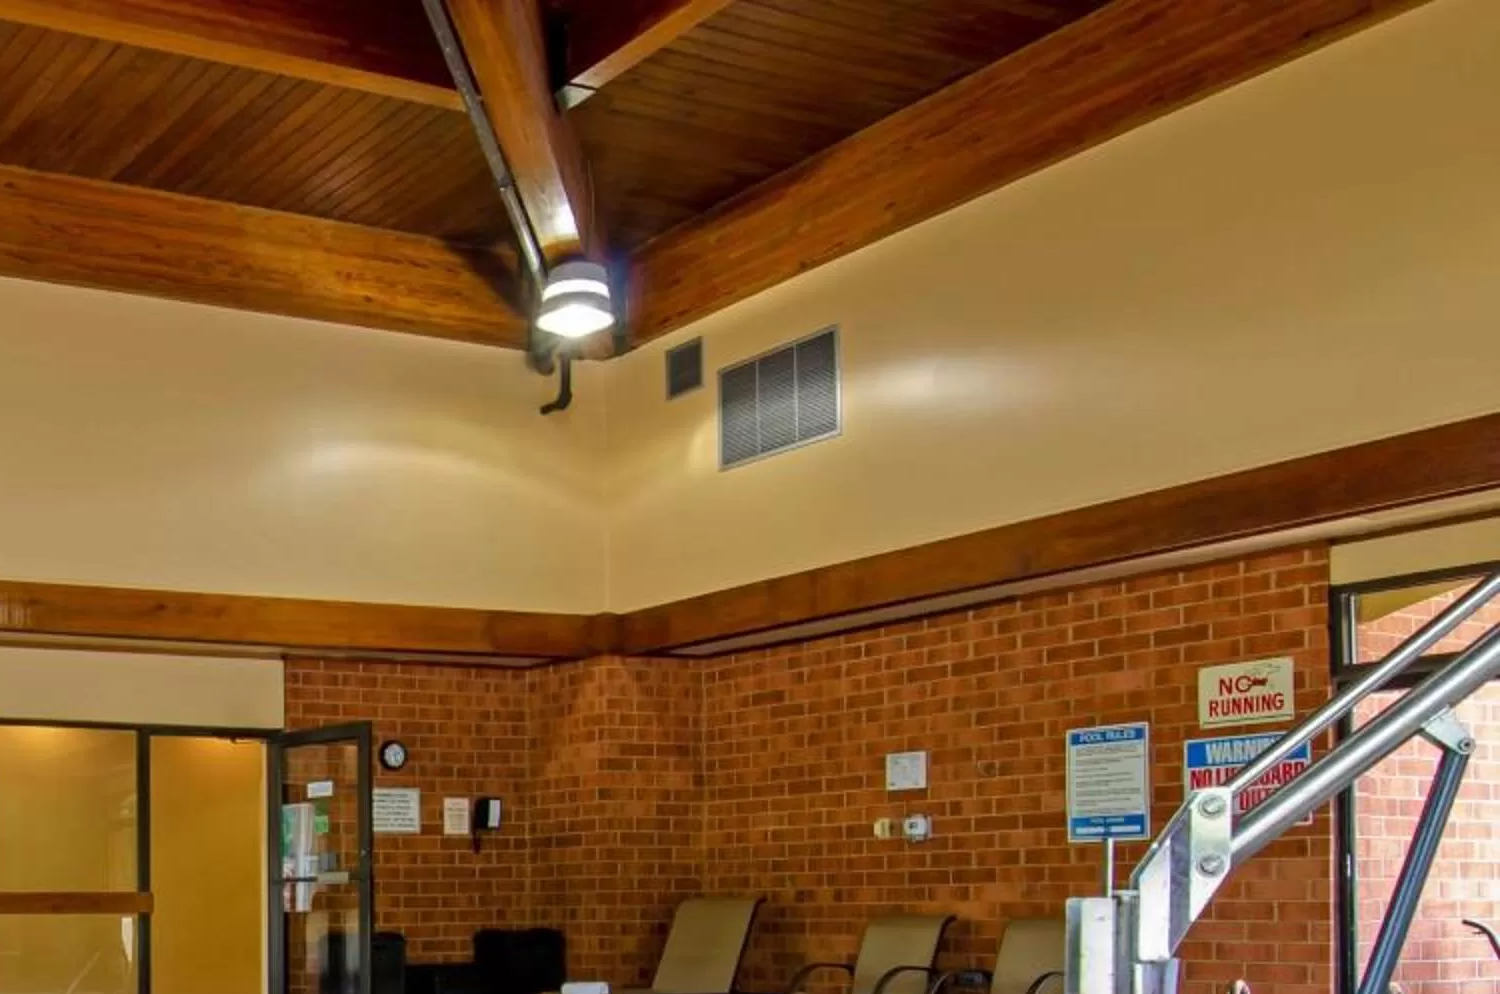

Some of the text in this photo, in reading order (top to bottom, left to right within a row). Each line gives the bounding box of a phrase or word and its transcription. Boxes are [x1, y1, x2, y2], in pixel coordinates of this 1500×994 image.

[1219, 676, 1253, 696] NO
[1209, 693, 1285, 717] RUNNING
[1190, 768, 1212, 790] NO
